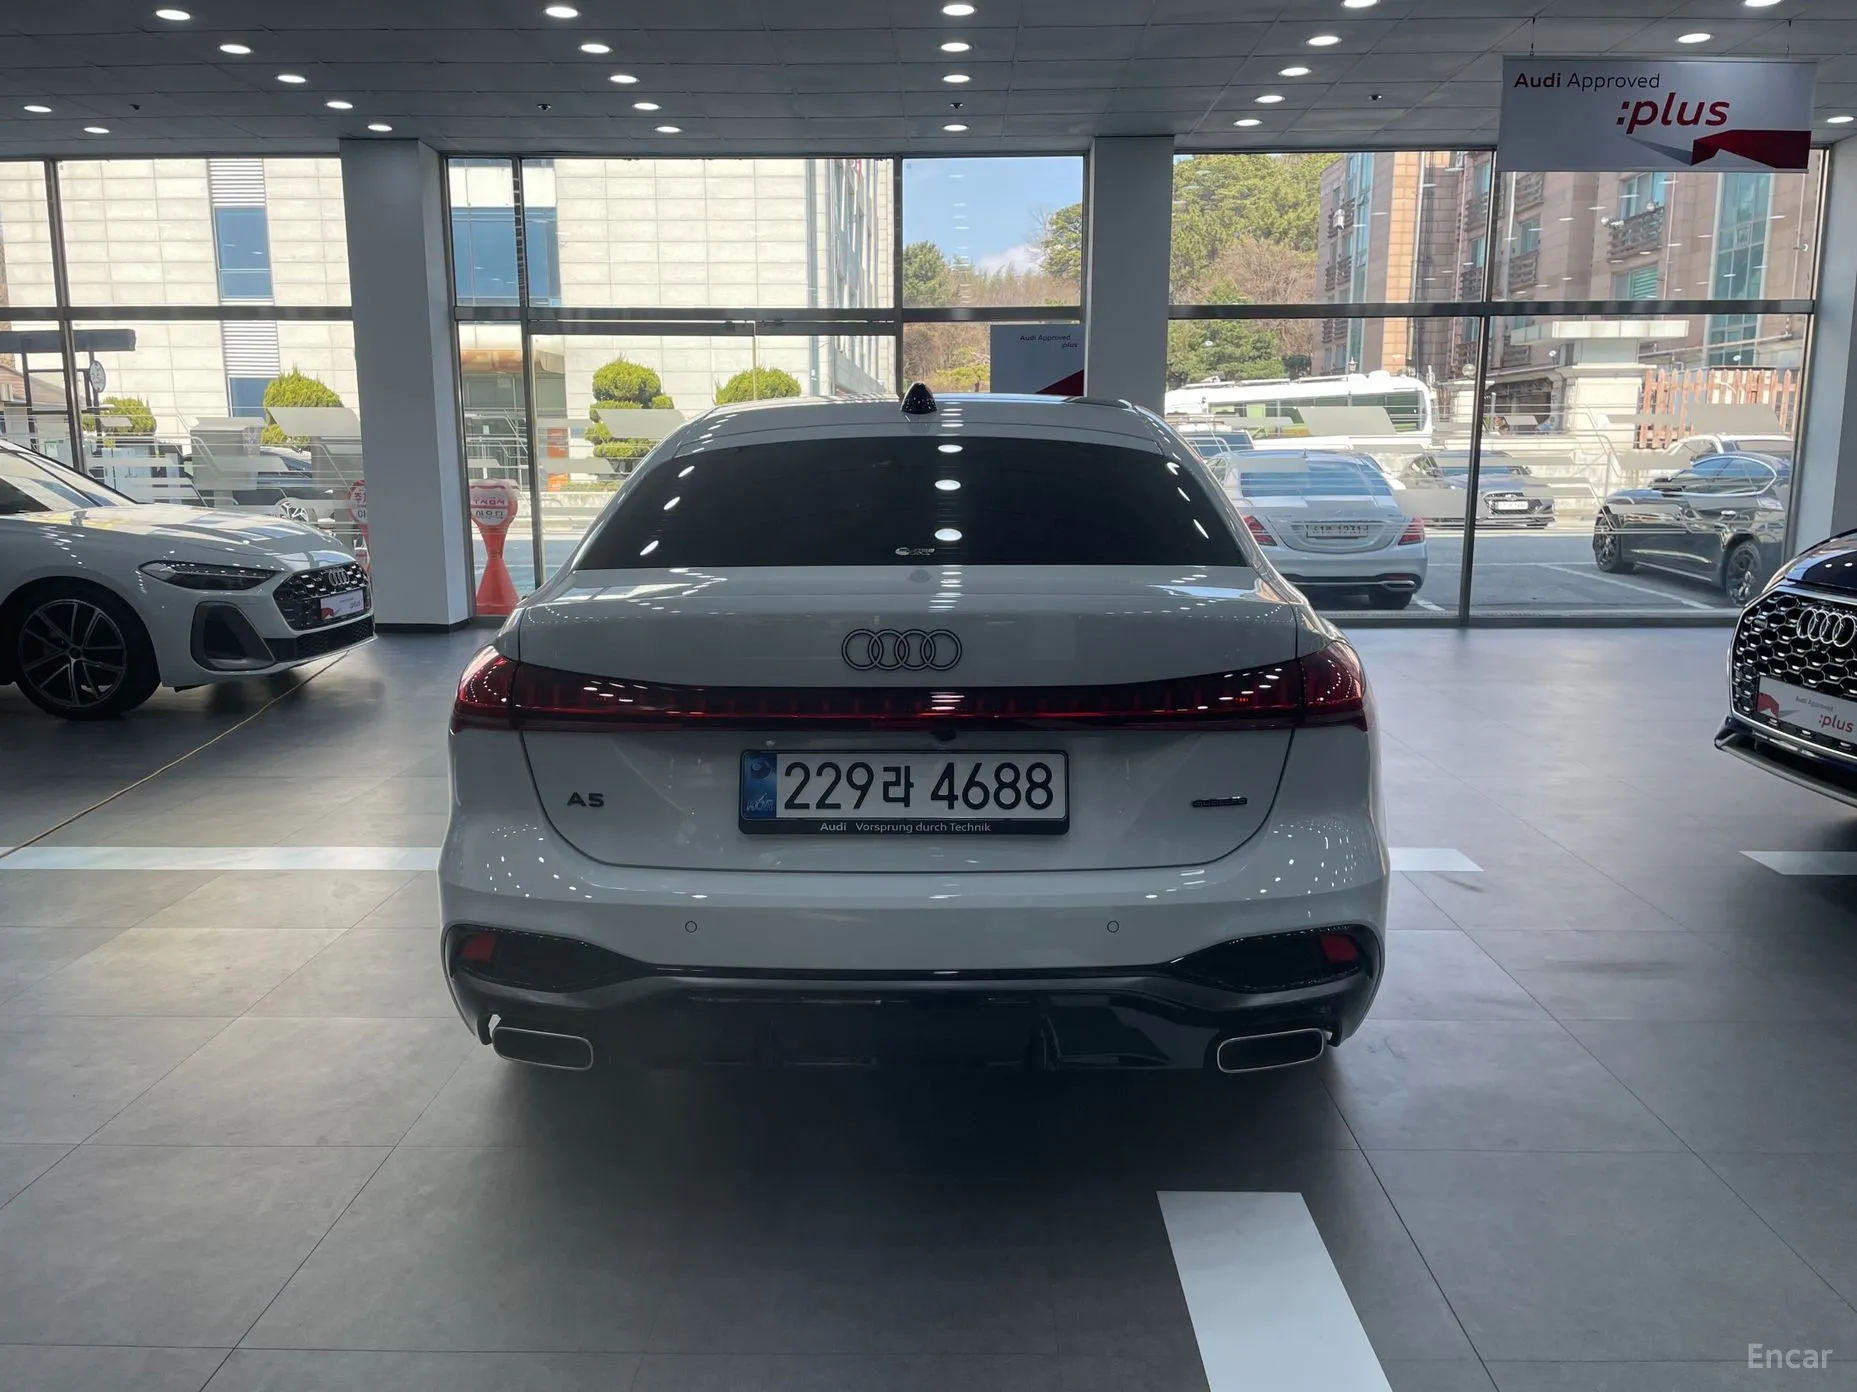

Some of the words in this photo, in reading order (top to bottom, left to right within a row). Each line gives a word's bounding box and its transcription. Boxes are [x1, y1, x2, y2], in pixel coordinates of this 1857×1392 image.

[1513, 72, 1561, 88] Audi
[1566, 72, 1661, 92] Approved
[1616, 92, 1730, 135] :plus
[784, 761, 914, 810] 229라
[930, 762, 1054, 811] 4688
[567, 792, 605, 807] A5
[819, 822, 847, 831] Audi
[855, 822, 913, 834] Vorsprung
[915, 822, 947, 831] durch
[950, 822, 991, 832] Technik
